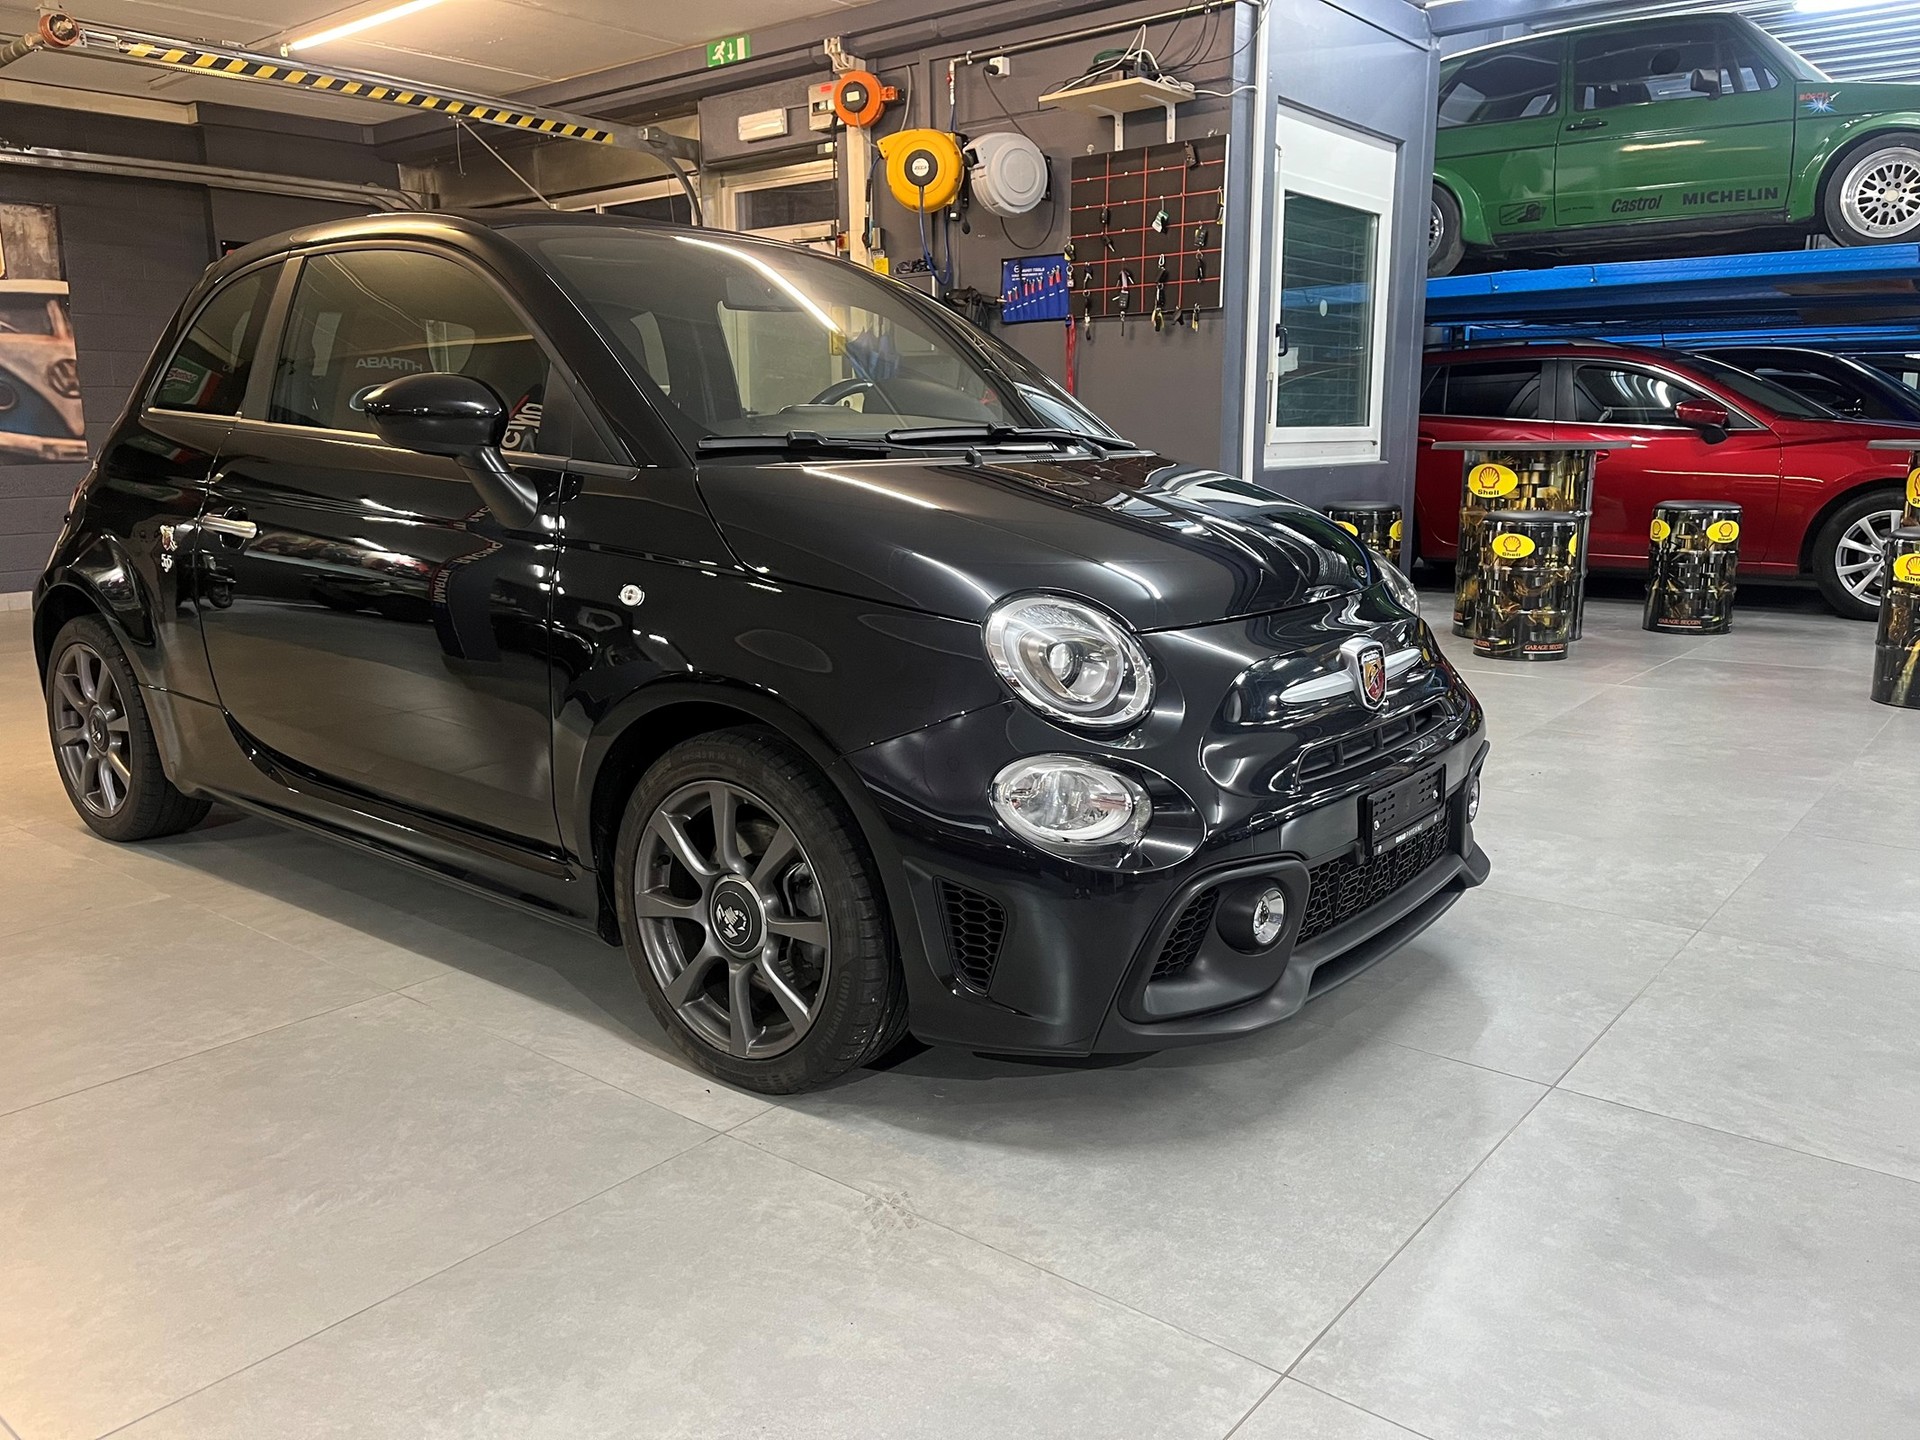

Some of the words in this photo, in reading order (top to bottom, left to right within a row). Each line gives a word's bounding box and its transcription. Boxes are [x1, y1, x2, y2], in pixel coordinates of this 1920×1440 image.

[1611, 195, 1663, 213] Castrol
[1682, 187, 1778, 206] MICHELIN
[355, 356, 423, 372] ABARTH
